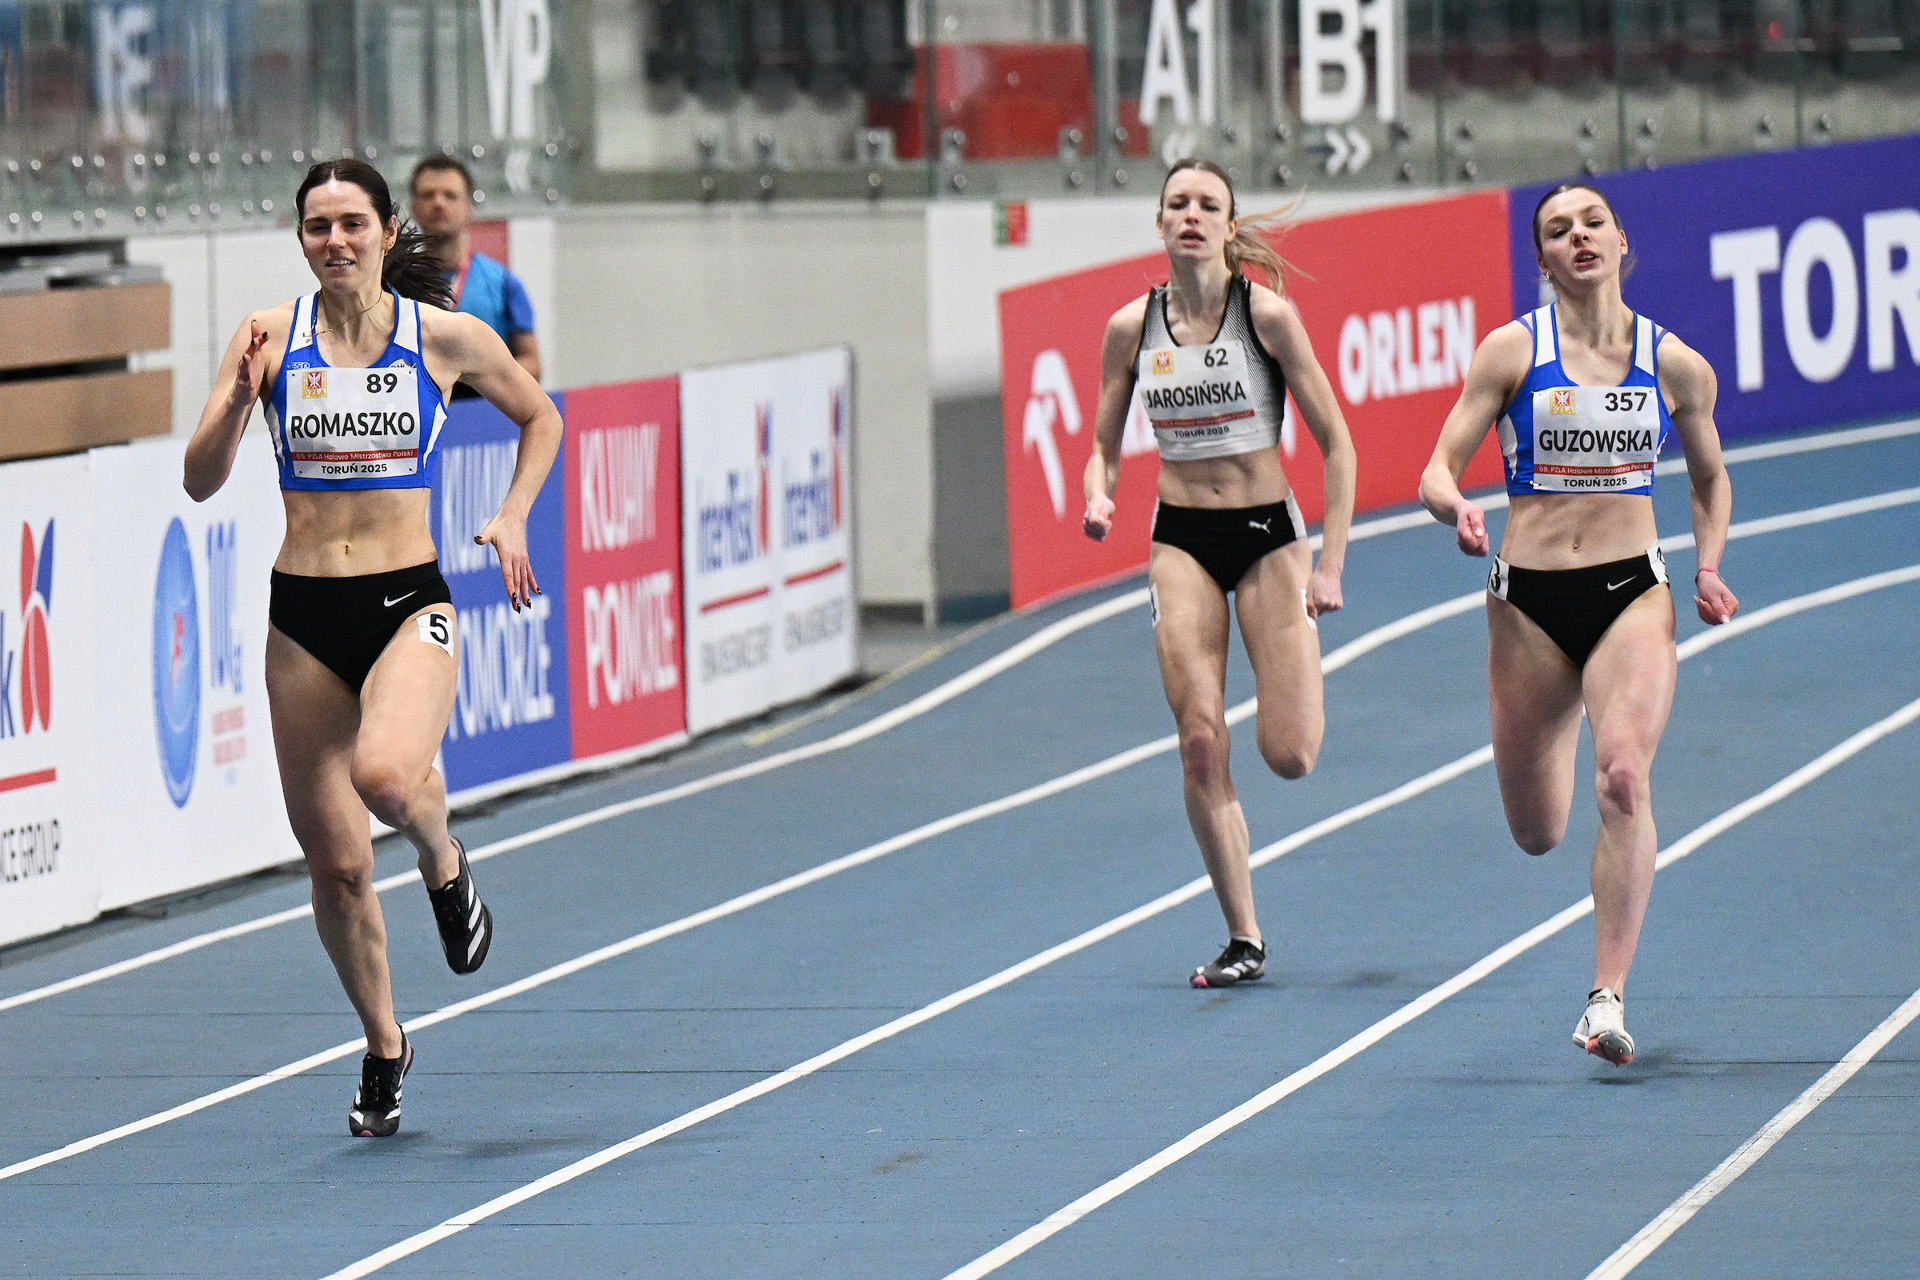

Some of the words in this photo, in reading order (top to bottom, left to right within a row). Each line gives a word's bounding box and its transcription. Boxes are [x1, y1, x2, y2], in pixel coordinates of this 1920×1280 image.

[1139, 0, 1214, 126] A1
[1300, 0, 1396, 123] B1
[1710, 207, 1920, 393] TOR
[1203, 348, 1229, 368] 62
[1338, 295, 1476, 407] ORLEN
[366, 373, 398, 393] 89
[1146, 380, 1247, 409] JAROSIŃSKA
[1605, 392, 1647, 412] 357
[290, 412, 415, 439] ROMASZKO
[392, 449, 413, 457] Polski
[1538, 429, 1653, 452] GUZOWSKA
[321, 463, 358, 474] TORUŃ
[360, 463, 388, 473] 2025
[1550, 466, 1567, 474] PZLA
[1563, 477, 1601, 487] TORUŃ
[1603, 477, 1628, 487] 2025
[429, 613, 449, 645] 5
[19, 817, 61, 879] GROUP
